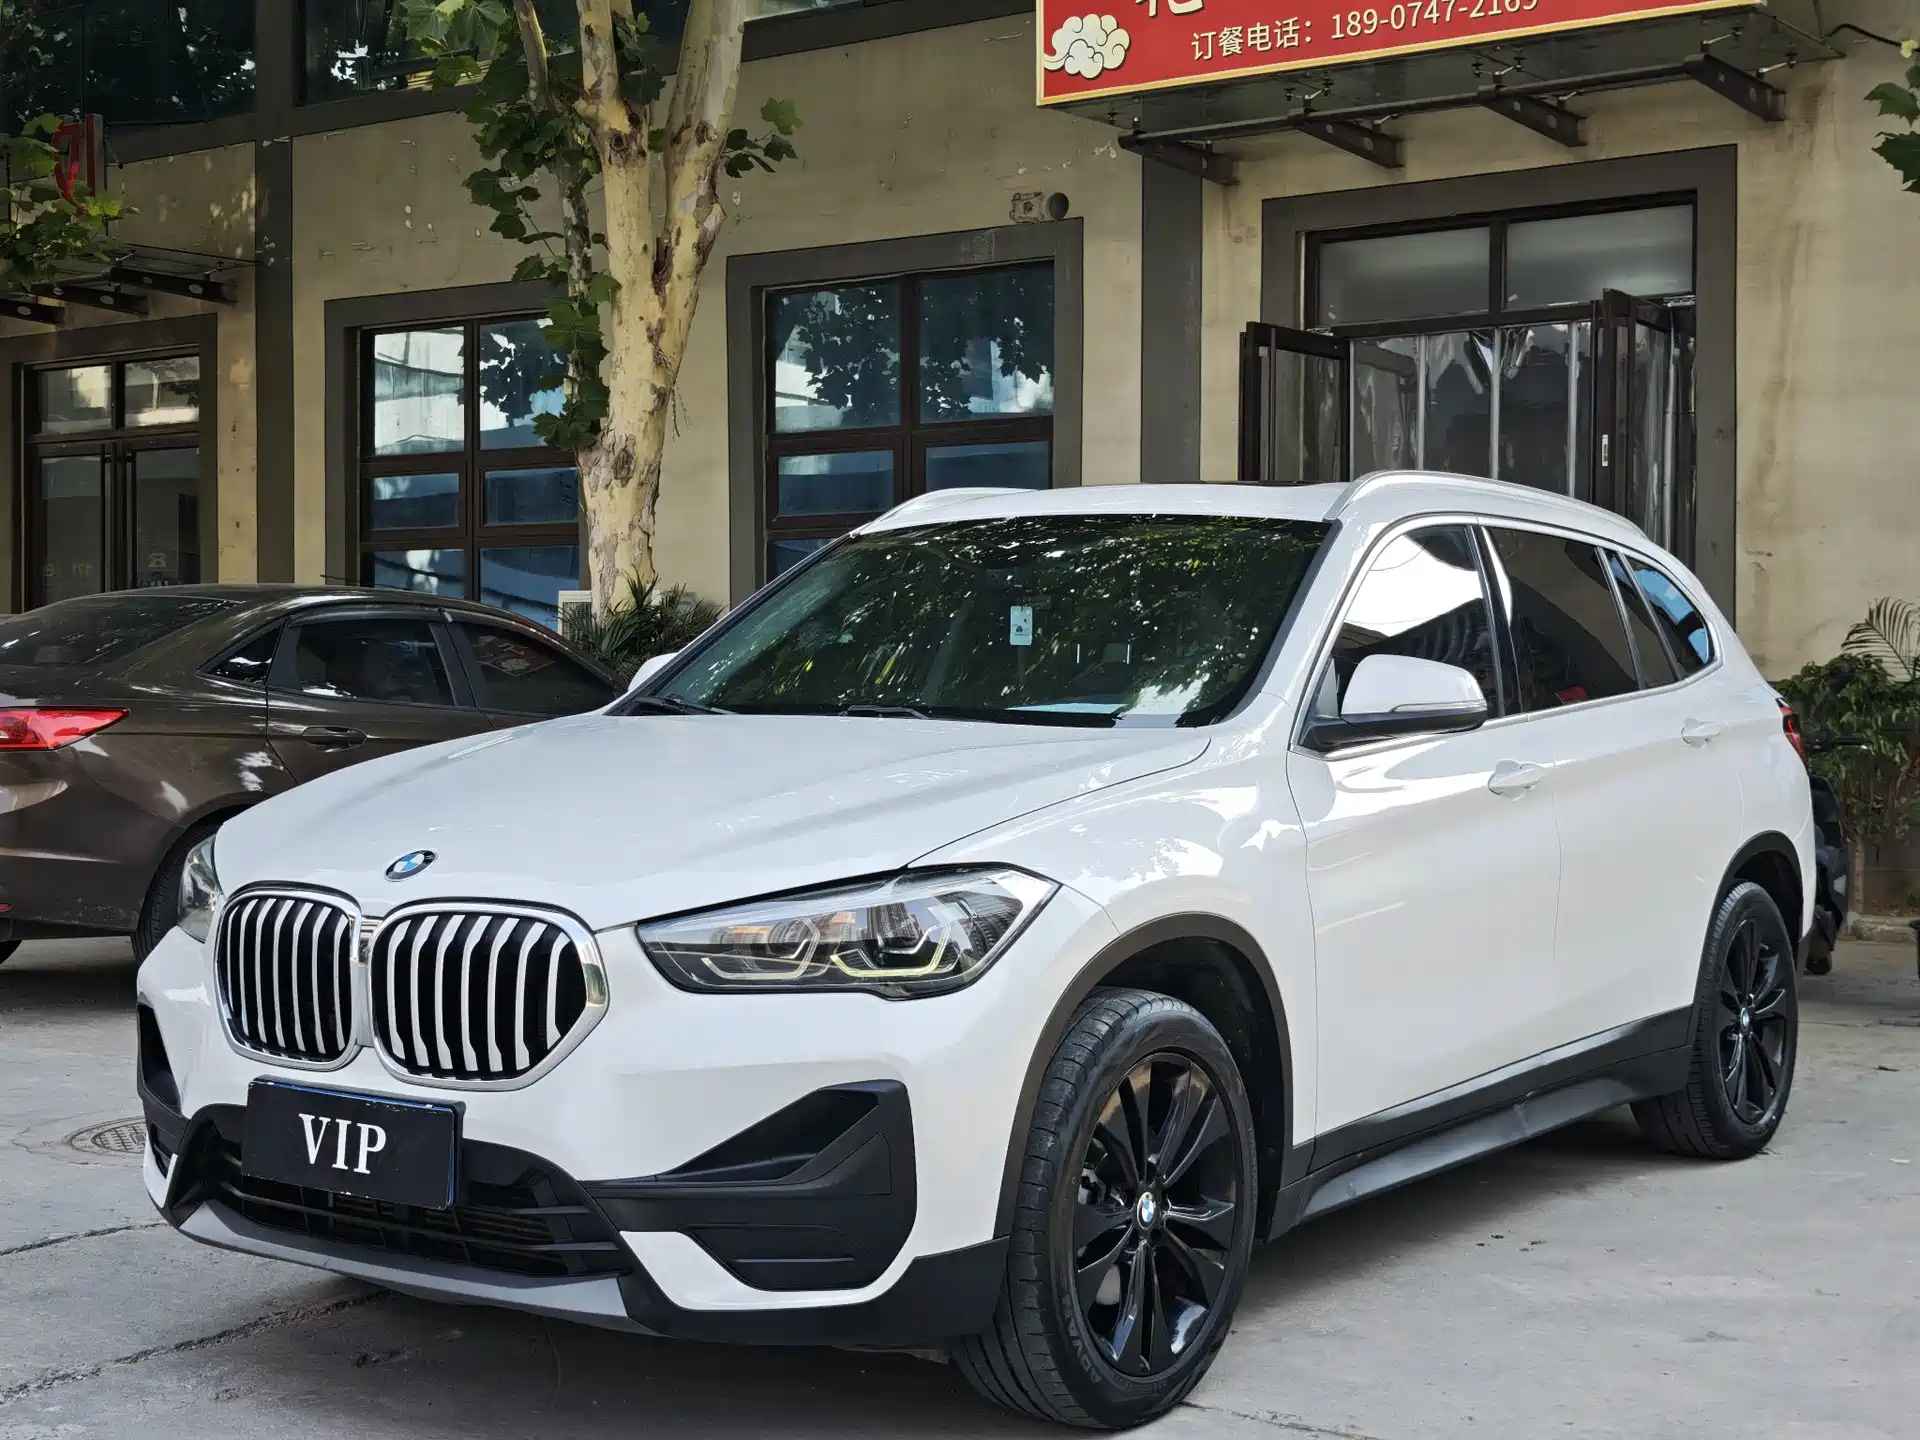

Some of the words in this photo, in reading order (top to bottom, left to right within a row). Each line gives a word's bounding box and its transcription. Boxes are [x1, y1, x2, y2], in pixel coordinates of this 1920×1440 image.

[1191, 16, 1312, 60] 订餐电话：
[298, 1113, 387, 1174] VIP
